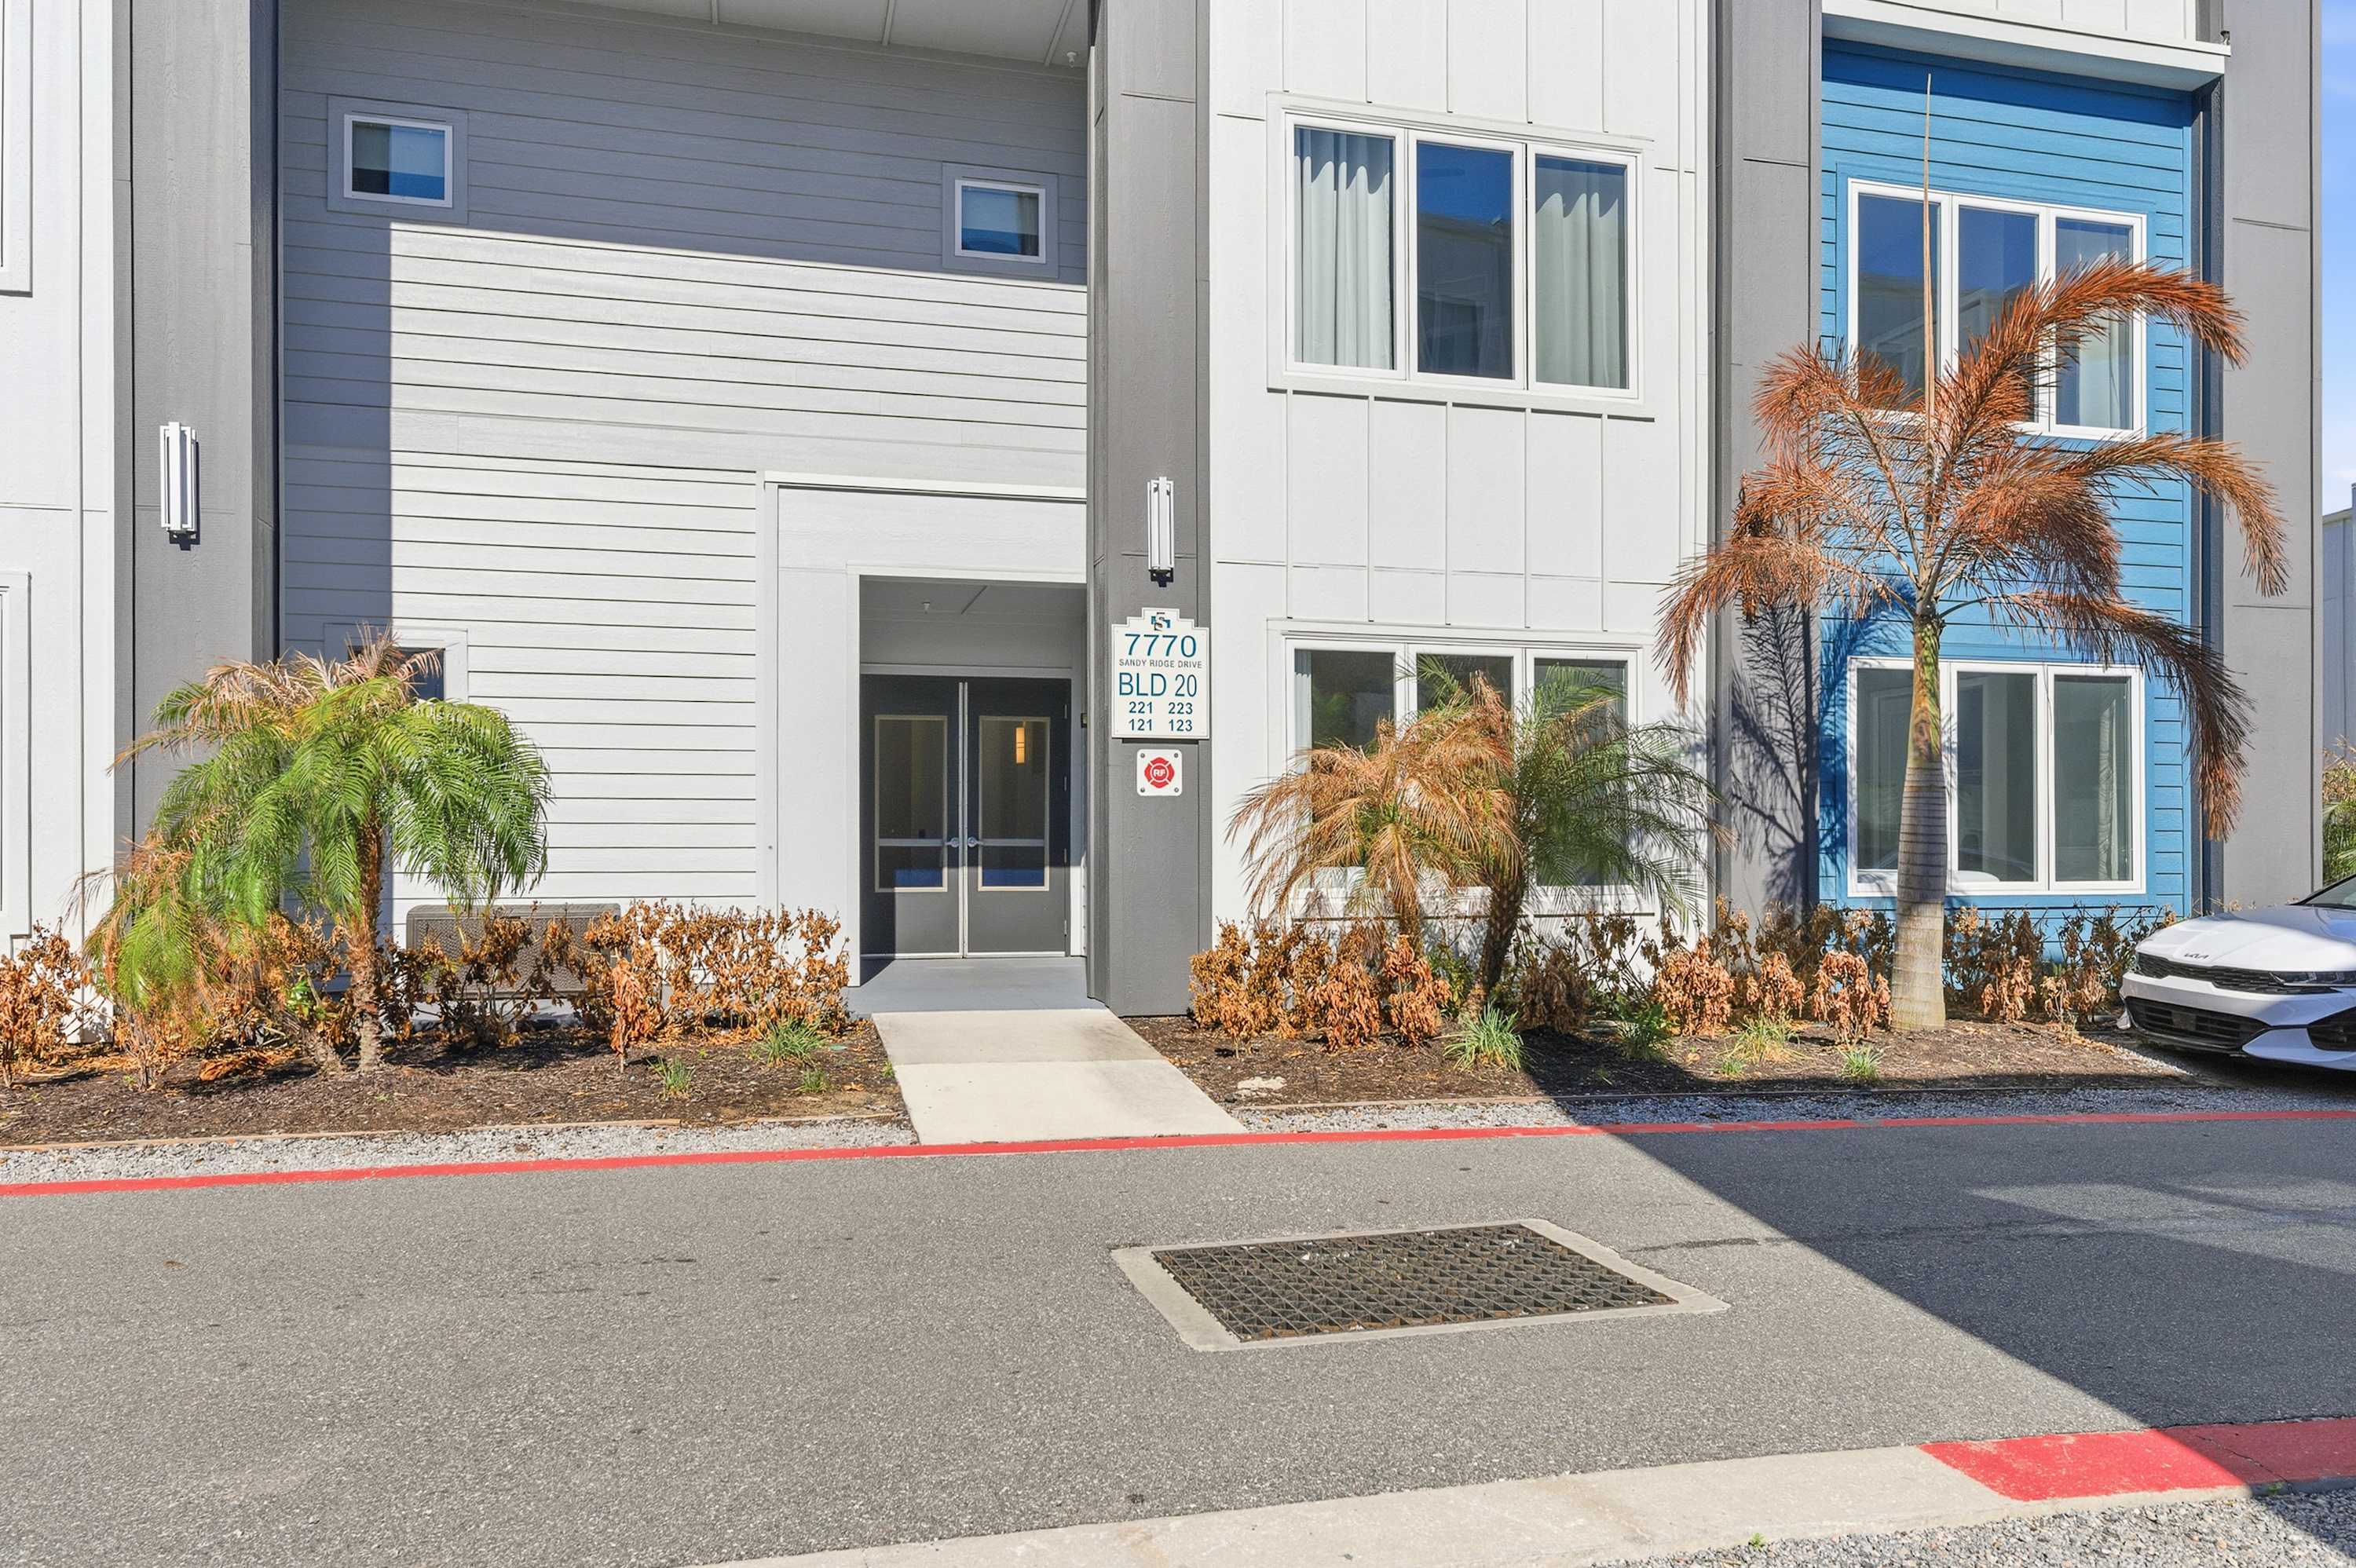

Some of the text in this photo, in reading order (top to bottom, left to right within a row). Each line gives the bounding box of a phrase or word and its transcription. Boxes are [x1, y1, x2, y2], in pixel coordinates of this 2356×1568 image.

[1125, 634, 1197, 657] 7770
[1119, 672, 1197, 697] BLD 20
[1129, 701, 1193, 715] 221 223
[1129, 718, 1193, 732] 121 123
